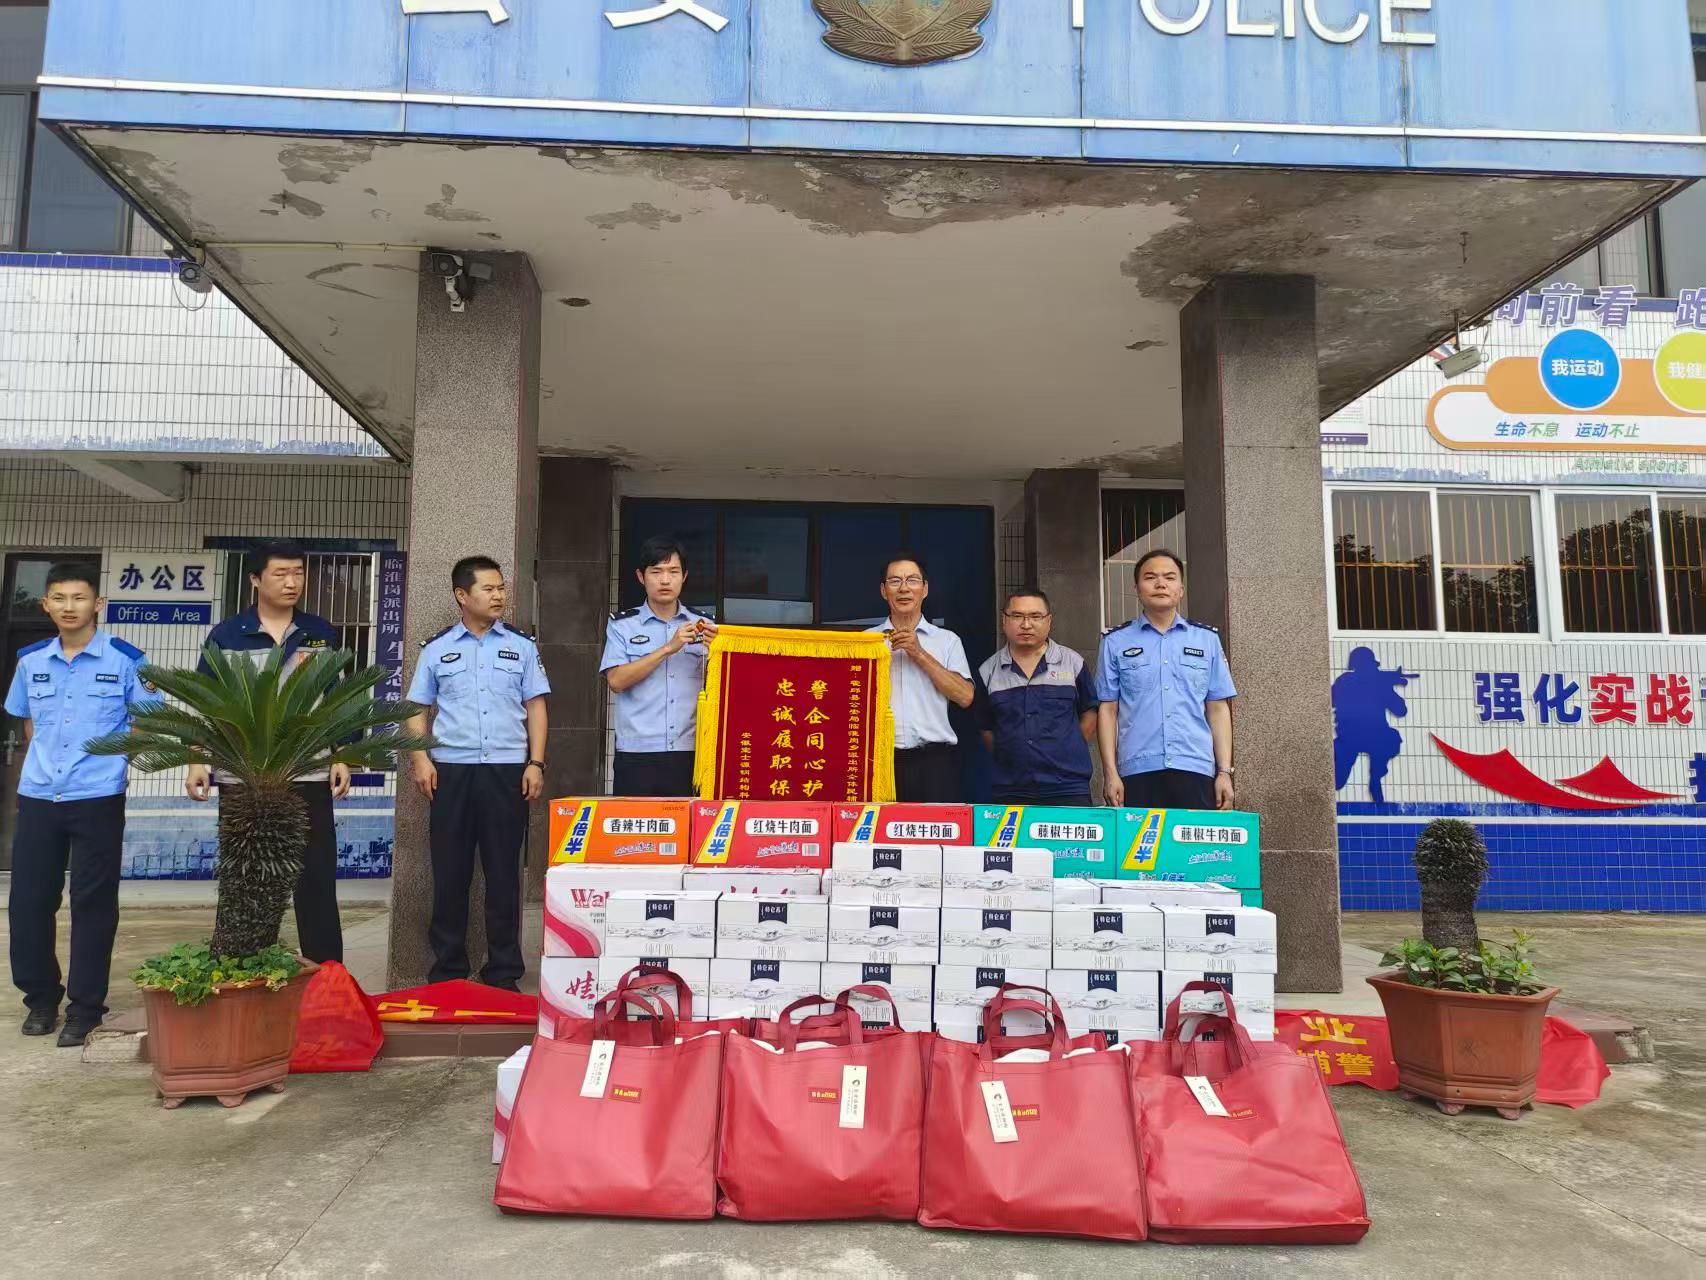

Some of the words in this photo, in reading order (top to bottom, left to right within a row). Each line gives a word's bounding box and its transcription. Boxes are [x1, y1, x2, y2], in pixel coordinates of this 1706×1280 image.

[1551, 359, 1605, 377] 我运动
[1493, 421, 1561, 438] 生命不息
[1575, 422, 1641, 438] 运动不止
[119, 563, 206, 591] 办公区
[118, 606, 160, 621] Office
[172, 607, 201, 622] Area
[1474, 672, 1706, 726] 强化实战
[769, 677, 797, 797] 忠诚履职保
[802, 679, 831, 798] 警企同心护
[564, 806, 592, 856] 1倍半
[610, 818, 670, 833] 香辣牛肉面
[707, 807, 735, 857] 1倍半
[753, 819, 812, 834] 红烧牛肉面
[854, 810, 875, 842] 1倍
[893, 823, 953, 838] 红烧牛肉面
[1037, 824, 1098, 839] 藤椒牛肉面
[1133, 814, 1161, 864] 1倍半
[1180, 827, 1241, 843] 藤椒牛肉面
[570, 888, 610, 909] Wa
[564, 969, 598, 1000] 娃
[1300, 1015, 1368, 1045] 业
